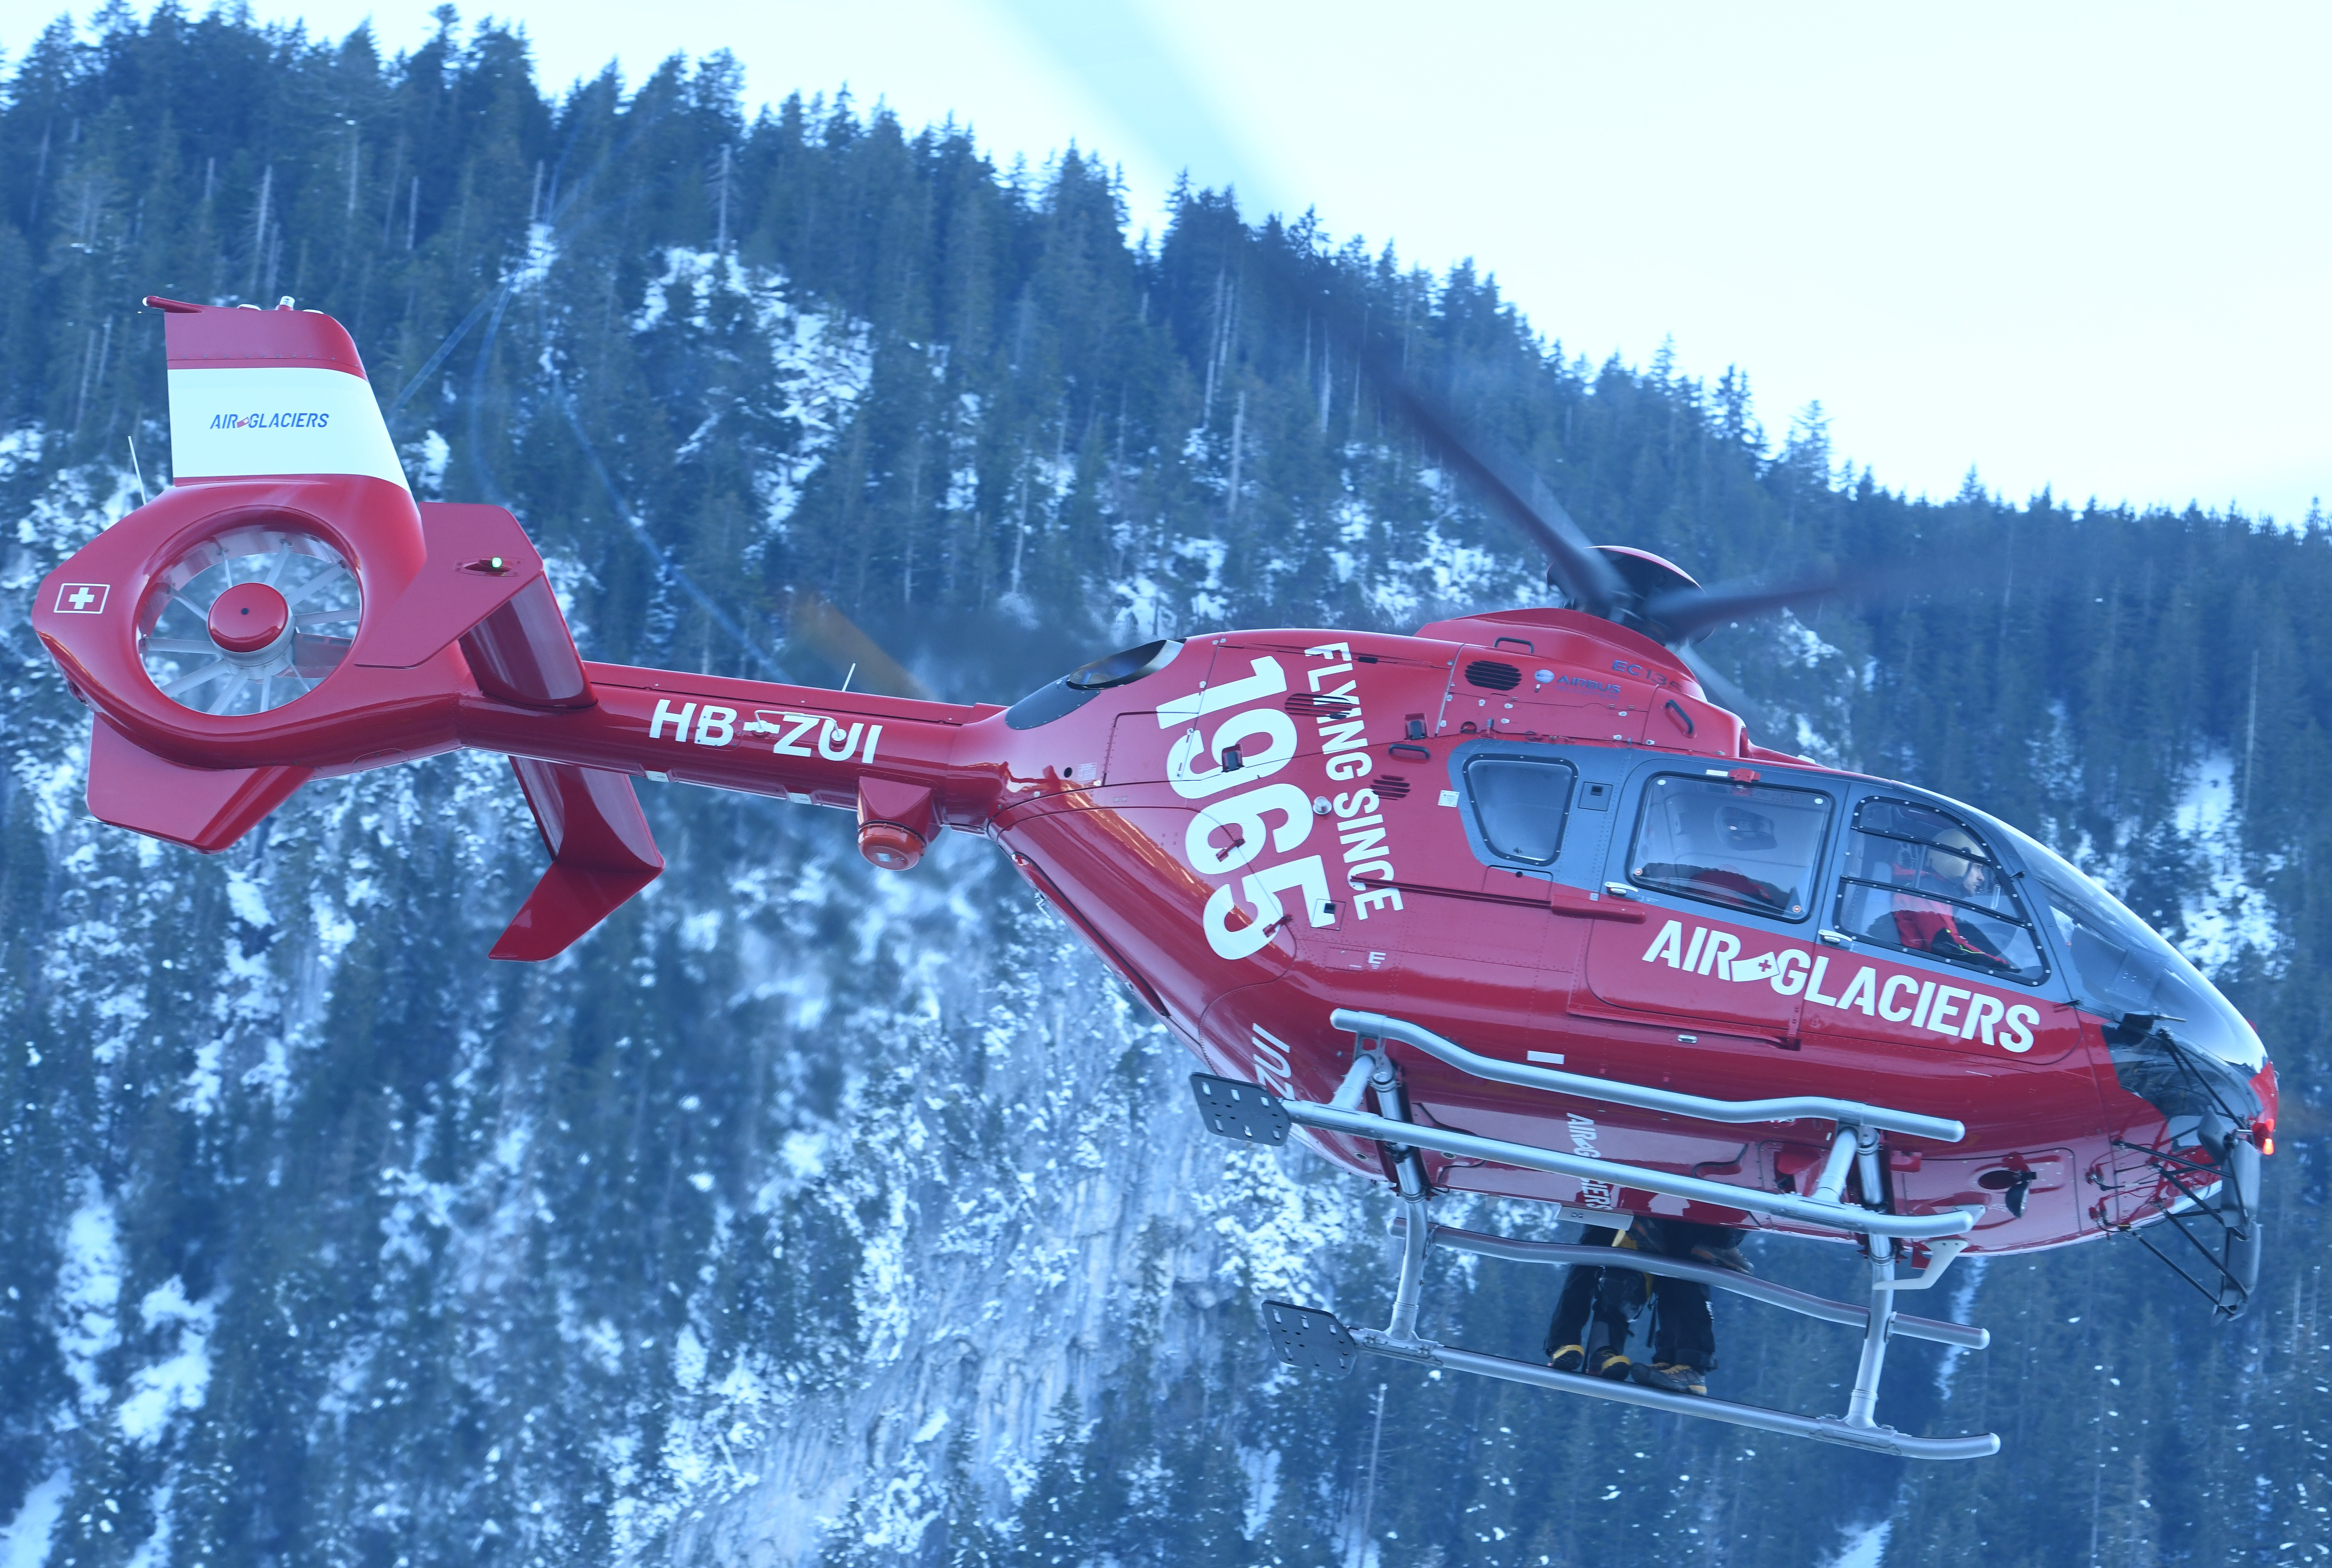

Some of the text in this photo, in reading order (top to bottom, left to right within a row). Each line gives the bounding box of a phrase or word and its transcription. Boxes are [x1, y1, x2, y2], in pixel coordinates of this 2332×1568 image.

[210, 413, 329, 429] AIR GLACIERS
[649, 699, 883, 764] HB-ZUI
[1557, 676, 1621, 693] AIRBUS
[1156, 656, 1336, 960] 1965
[1304, 642, 1404, 920] FLYING SINCE
[1642, 920, 2040, 1053] AIR GLACIERS
